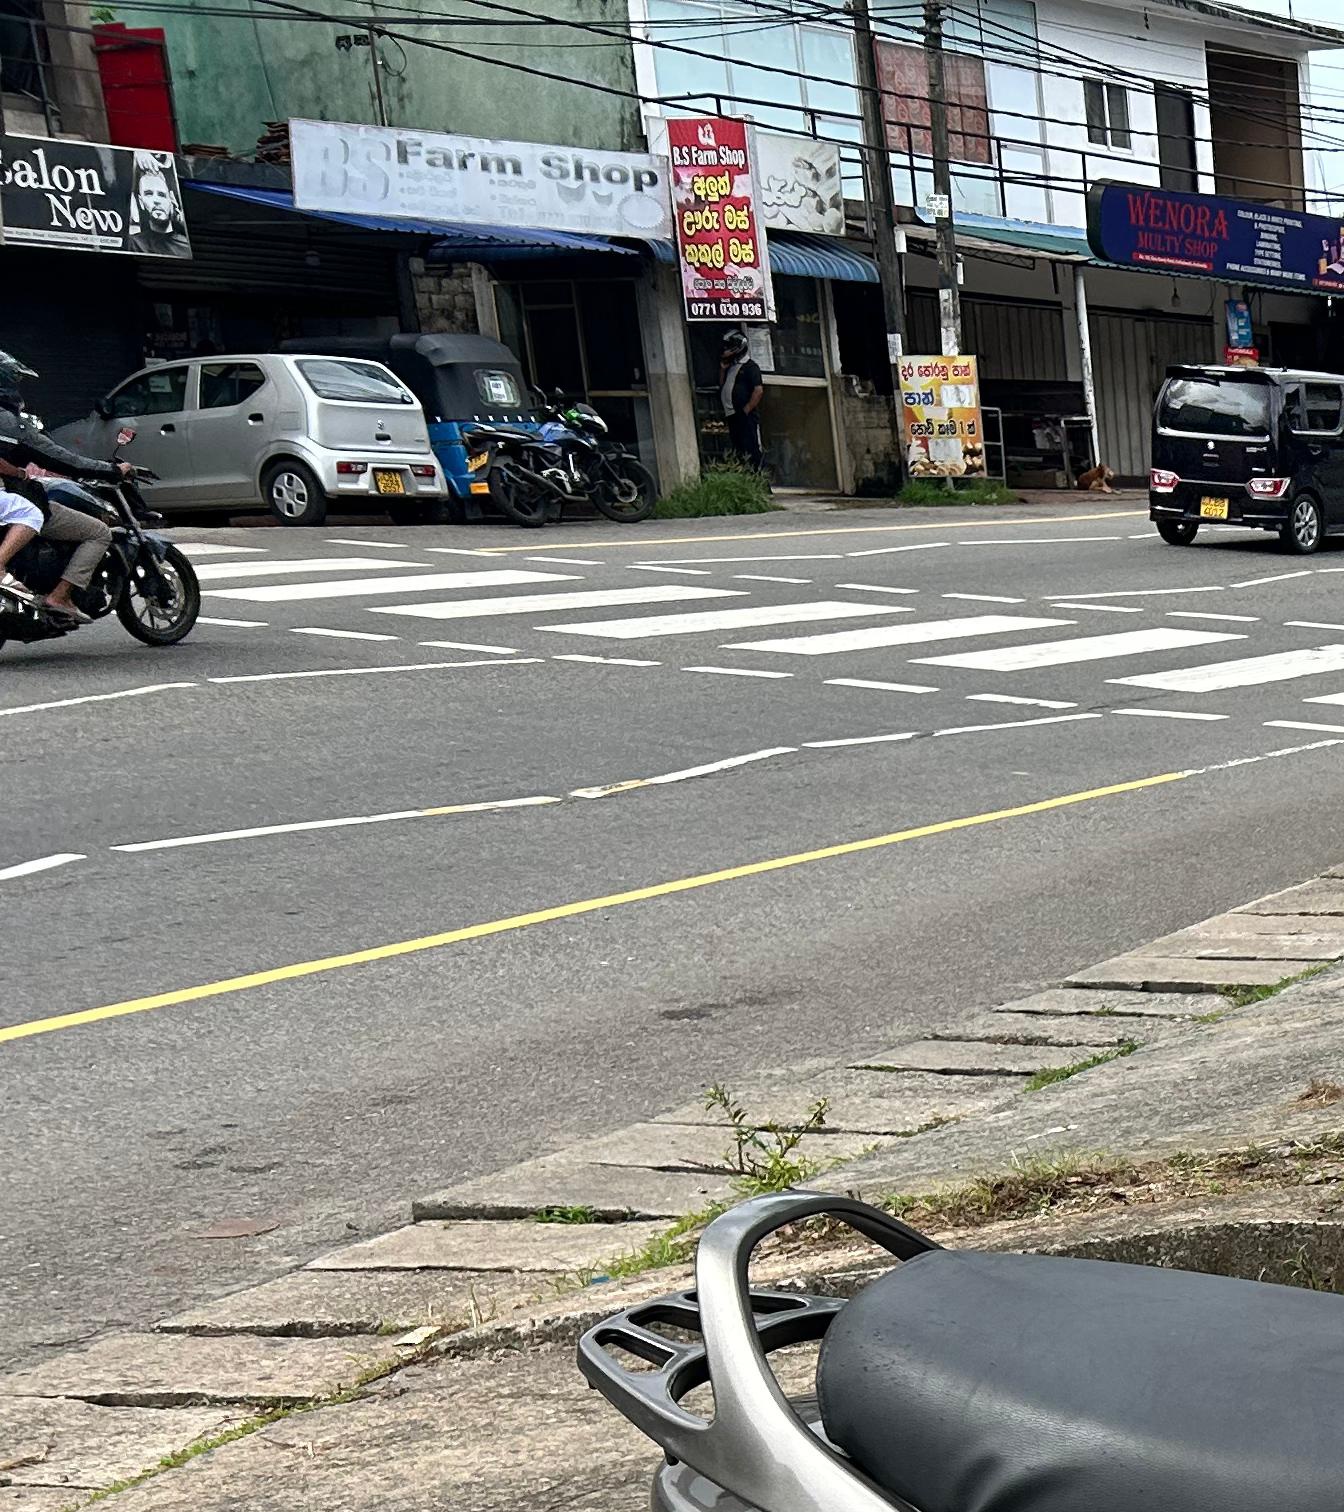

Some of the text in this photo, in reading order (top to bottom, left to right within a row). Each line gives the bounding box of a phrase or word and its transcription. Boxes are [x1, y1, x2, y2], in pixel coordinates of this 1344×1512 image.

[396, 138, 659, 192] Farm Shop
[691, 145, 718, 166] Farm
[719, 145, 745, 169] Shop
[45, 193, 123, 233] New
[1127, 191, 1229, 240] WENORA
[1184, 239, 1218, 258] SHOP
[691, 303, 762, 316] 0771 030 936
